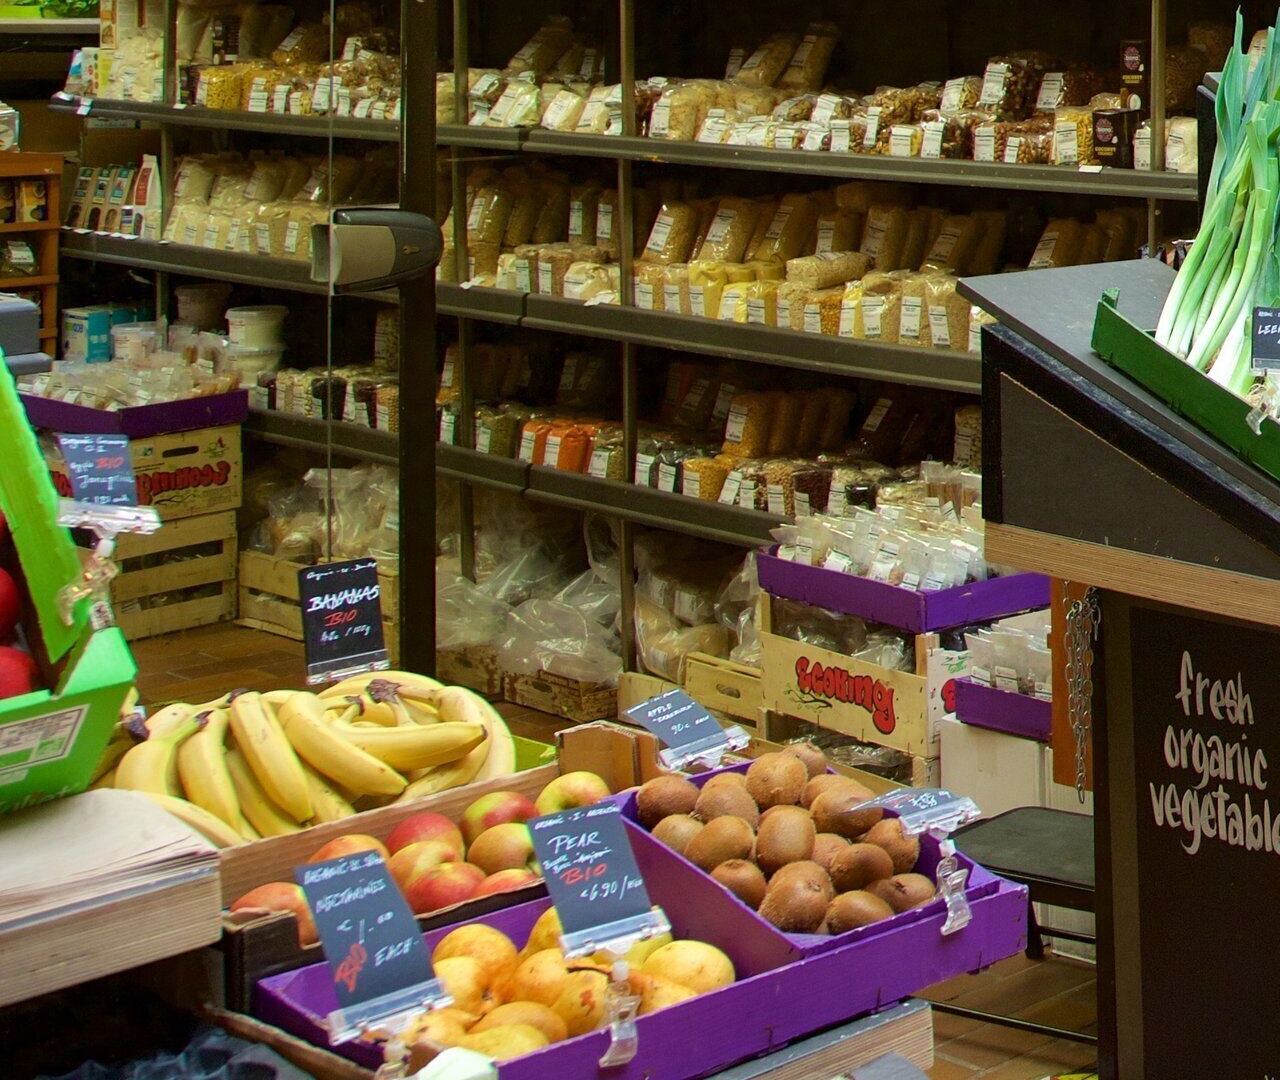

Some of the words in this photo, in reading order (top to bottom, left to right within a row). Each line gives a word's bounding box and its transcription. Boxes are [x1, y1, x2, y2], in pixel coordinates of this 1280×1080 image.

[307, 585, 381, 612] BANANAS
[324, 609, 357, 627] BIO
[1176, 650, 1255, 726] fresh
[1164, 725, 1268, 791] organic
[547, 831, 602, 854] PEAR
[560, 863, 607, 887] BIO
